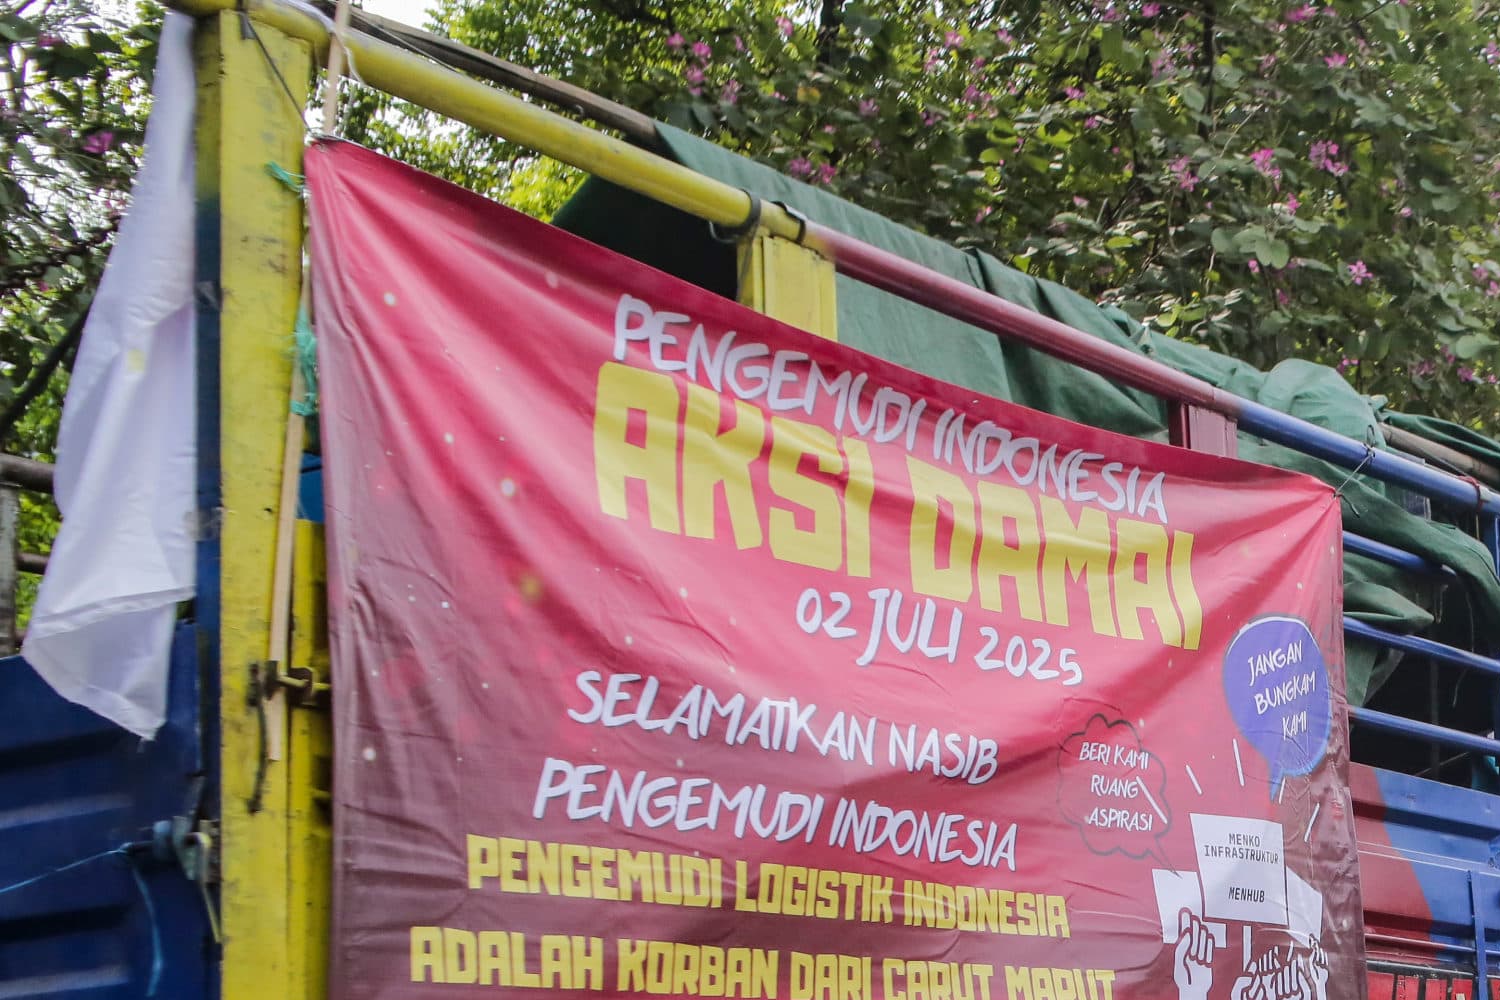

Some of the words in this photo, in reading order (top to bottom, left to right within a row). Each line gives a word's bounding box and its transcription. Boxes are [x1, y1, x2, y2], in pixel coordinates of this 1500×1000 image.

[613, 295, 928, 450] PENGEMUDI
[933, 413, 1169, 524] INDONESIA
[594, 361, 875, 578] AKSI
[906, 456, 1203, 651] DAMAI
[795, 587, 858, 639] 02
[856, 587, 963, 667] JULI
[973, 626, 1083, 687] 2025
[1247, 640, 1302, 686] JANGAN
[1254, 671, 1316, 715] BUNGKAM
[567, 670, 877, 767] SELAMATKAN
[888, 721, 998, 785] NASIB
[1282, 711, 1307, 741] KAMI
[1079, 741, 1111, 766] BERI
[1113, 744, 1150, 770] KAMI
[1090, 774, 1138, 798] RUANG
[533, 757, 825, 843] PENGEMUDI
[829, 797, 1017, 871] INDONESIA
[1087, 806, 1153, 832] ASPIRASI
[1204, 844, 1279, 865] INFRASTRUKTUR
[1228, 832, 1260, 847] MENKO
[467, 834, 723, 908] PENGEMUDI
[735, 861, 894, 923] LOGISTIK
[903, 879, 1071, 939] INDONESIA
[1228, 886, 1265, 903] MENHUB
[411, 926, 604, 993] ADALAH
[617, 938, 780, 1000] KORBAN
